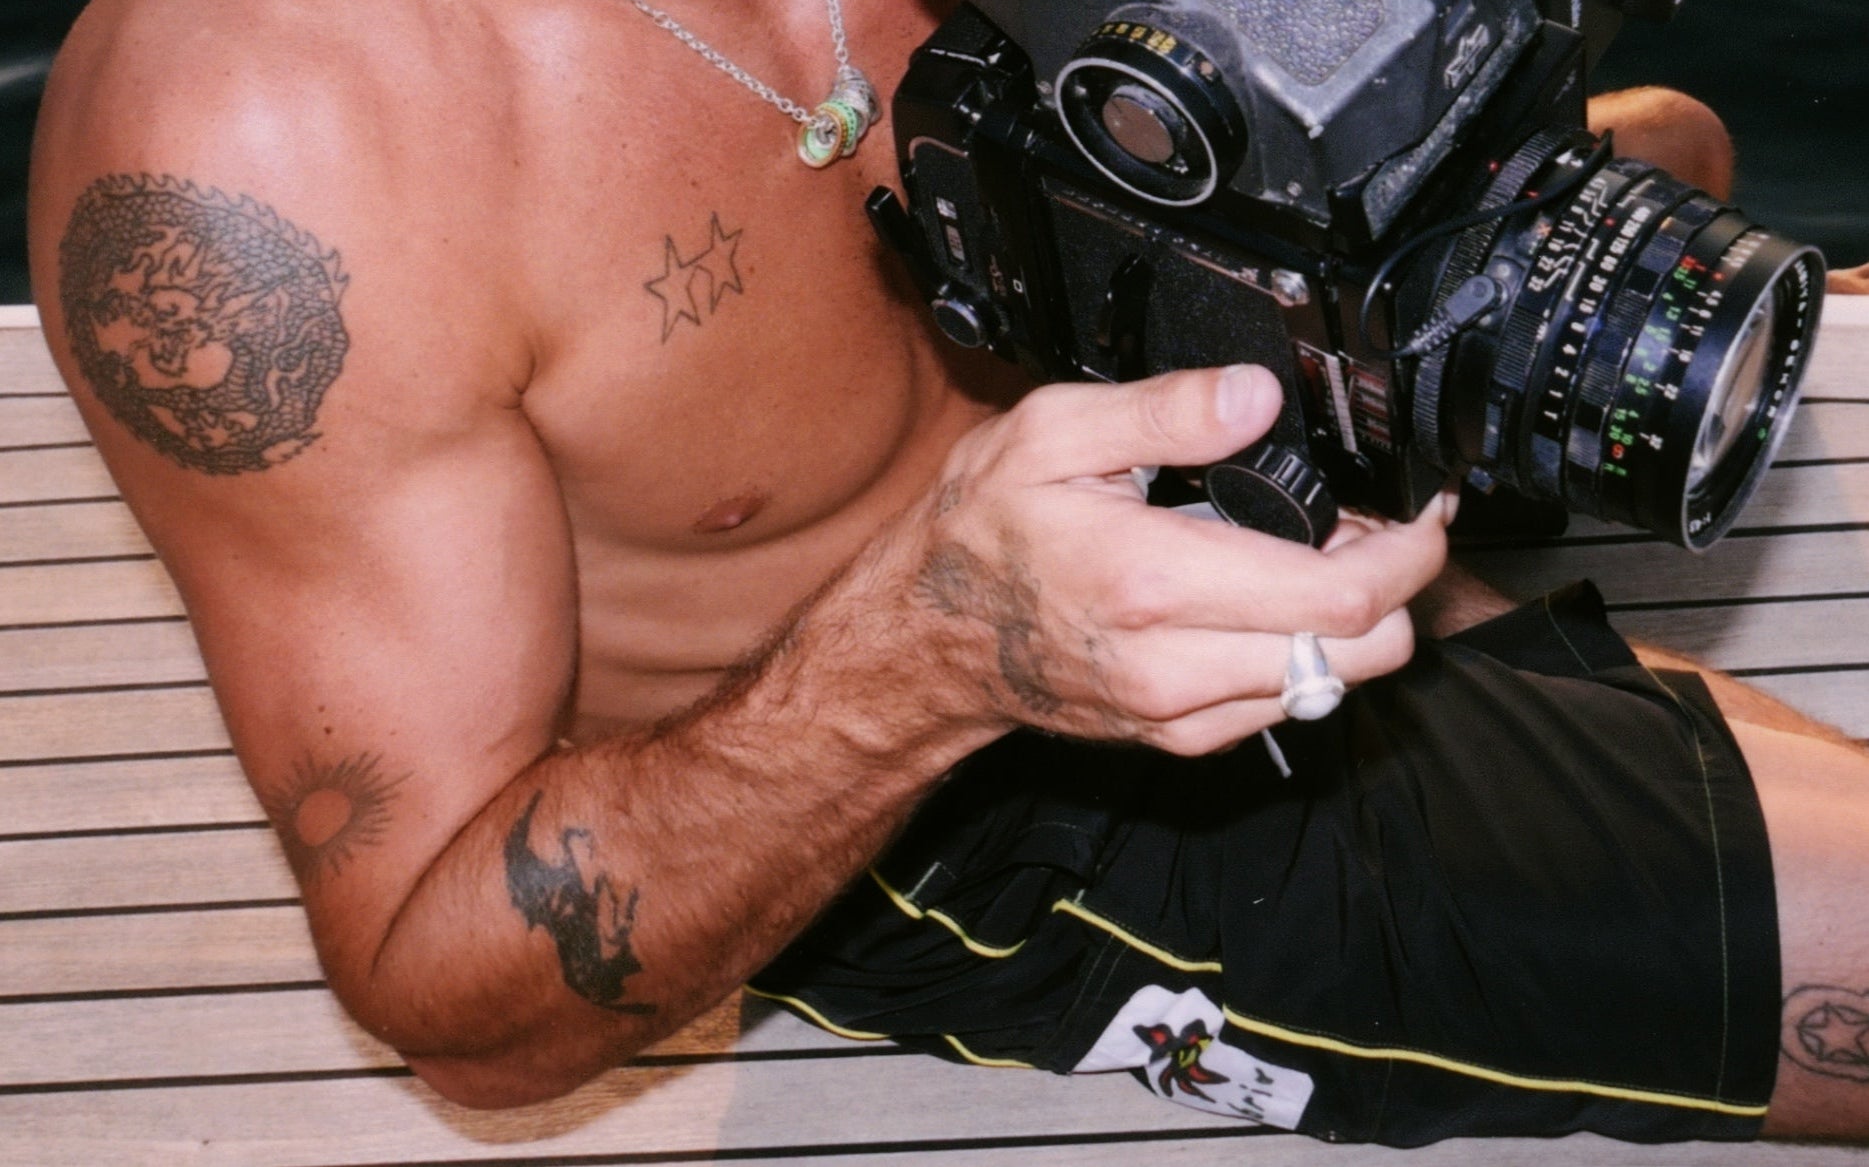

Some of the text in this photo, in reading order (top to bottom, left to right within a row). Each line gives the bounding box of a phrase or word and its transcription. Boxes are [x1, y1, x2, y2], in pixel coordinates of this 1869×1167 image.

[1609, 236, 1630, 255] 125
[1600, 254, 1618, 272] 60
[1588, 274, 1608, 293] 30
[1562, 343, 1577, 355] 4
[1554, 365, 1569, 378] 2
